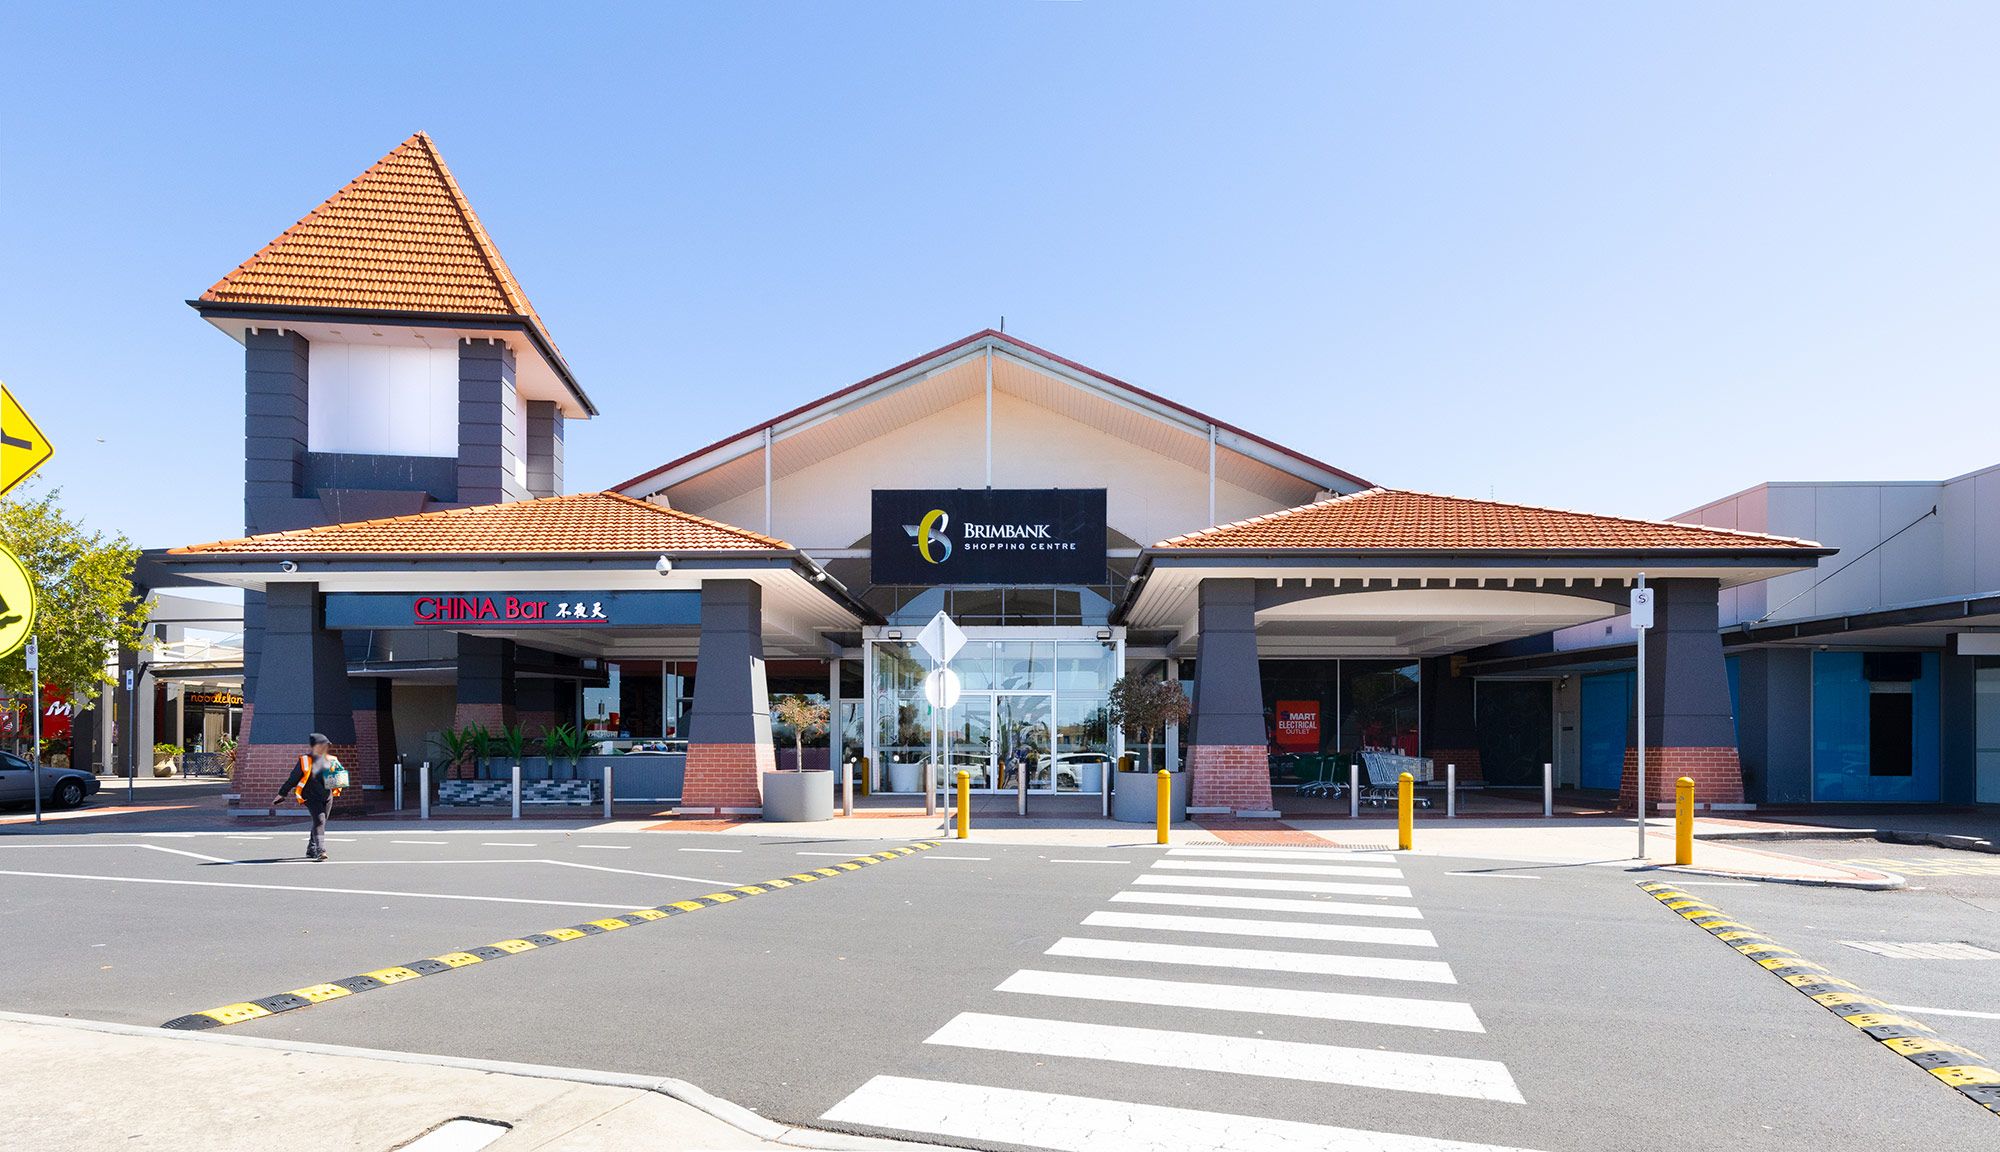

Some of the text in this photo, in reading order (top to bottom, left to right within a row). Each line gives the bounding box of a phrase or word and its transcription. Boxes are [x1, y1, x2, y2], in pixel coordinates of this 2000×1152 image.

[964, 522, 1052, 539] BRIMBANK
[414, 597, 549, 619] CHINA Bar
[1278, 720, 1318, 730] ELECTRICAL
